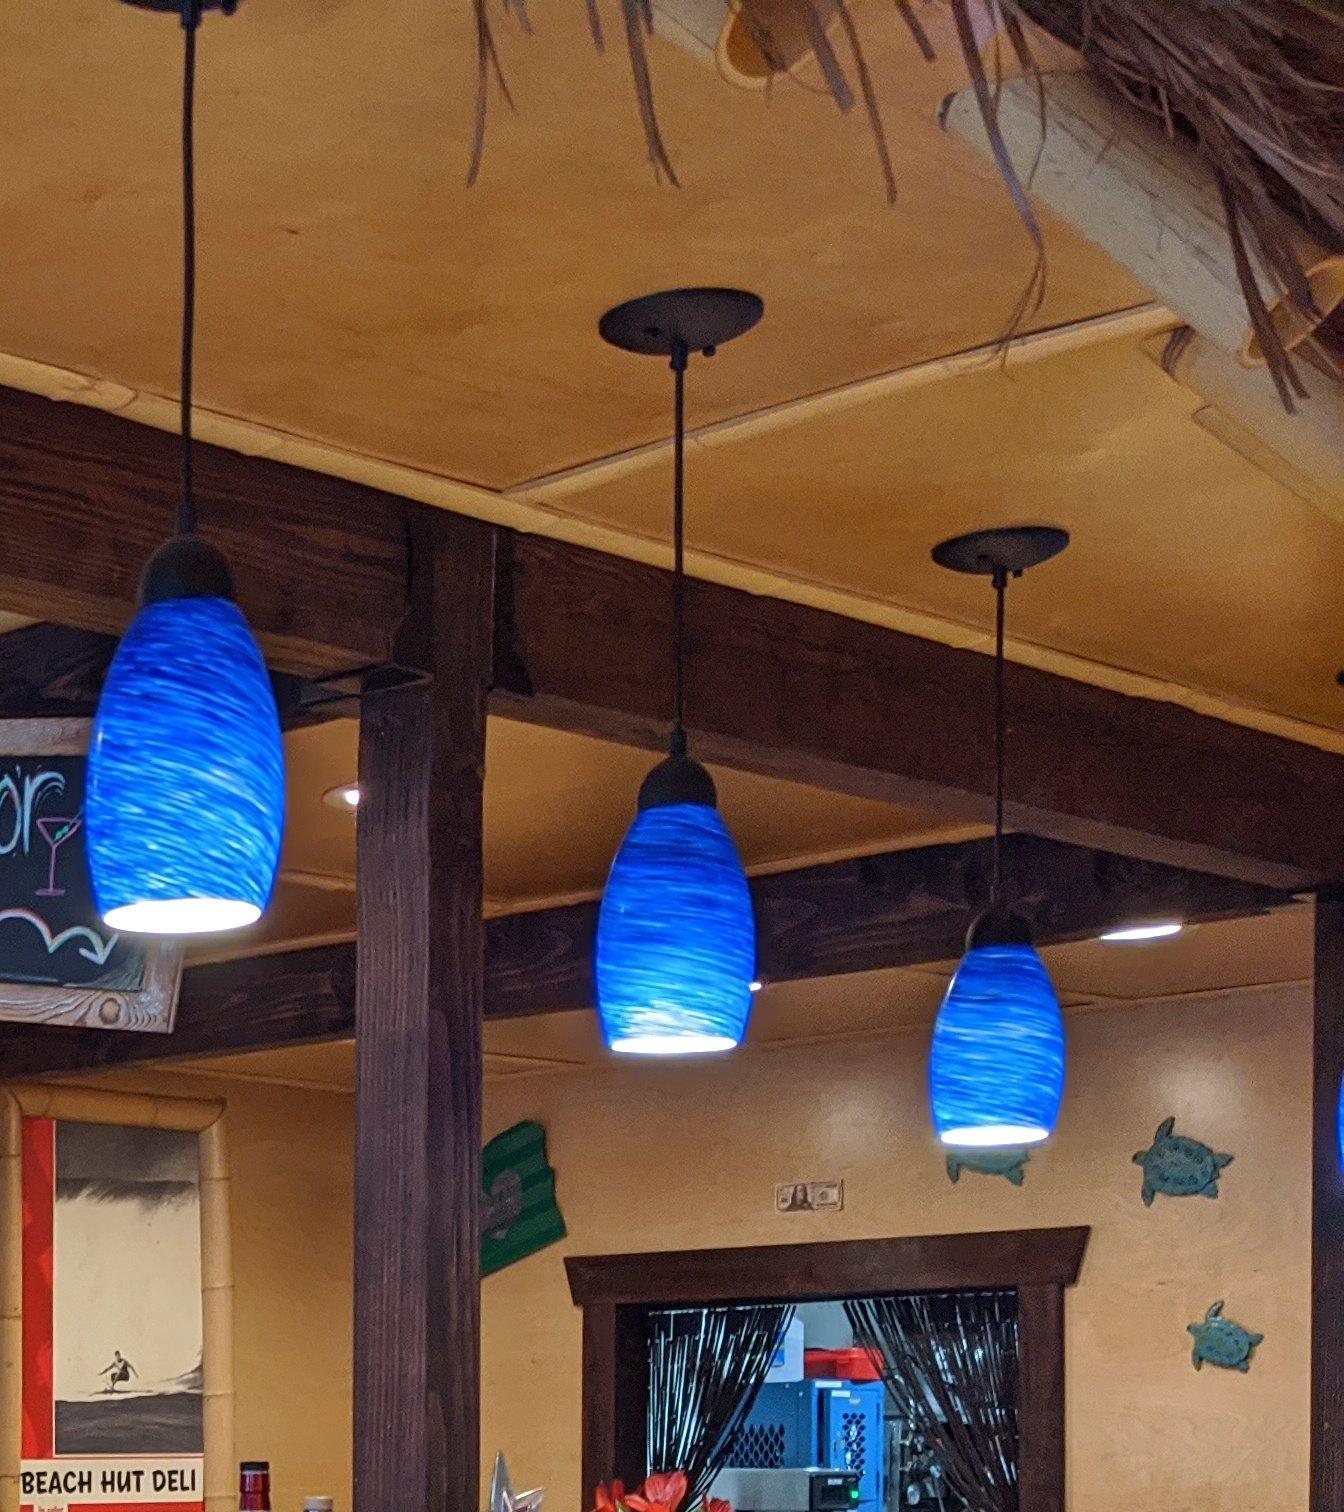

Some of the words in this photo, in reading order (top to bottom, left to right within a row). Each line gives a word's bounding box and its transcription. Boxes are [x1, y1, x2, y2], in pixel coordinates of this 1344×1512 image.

[21, 1470, 93, 1495] BEACH
[101, 1470, 145, 1494] HUT
[152, 1468, 197, 1492] DELI
